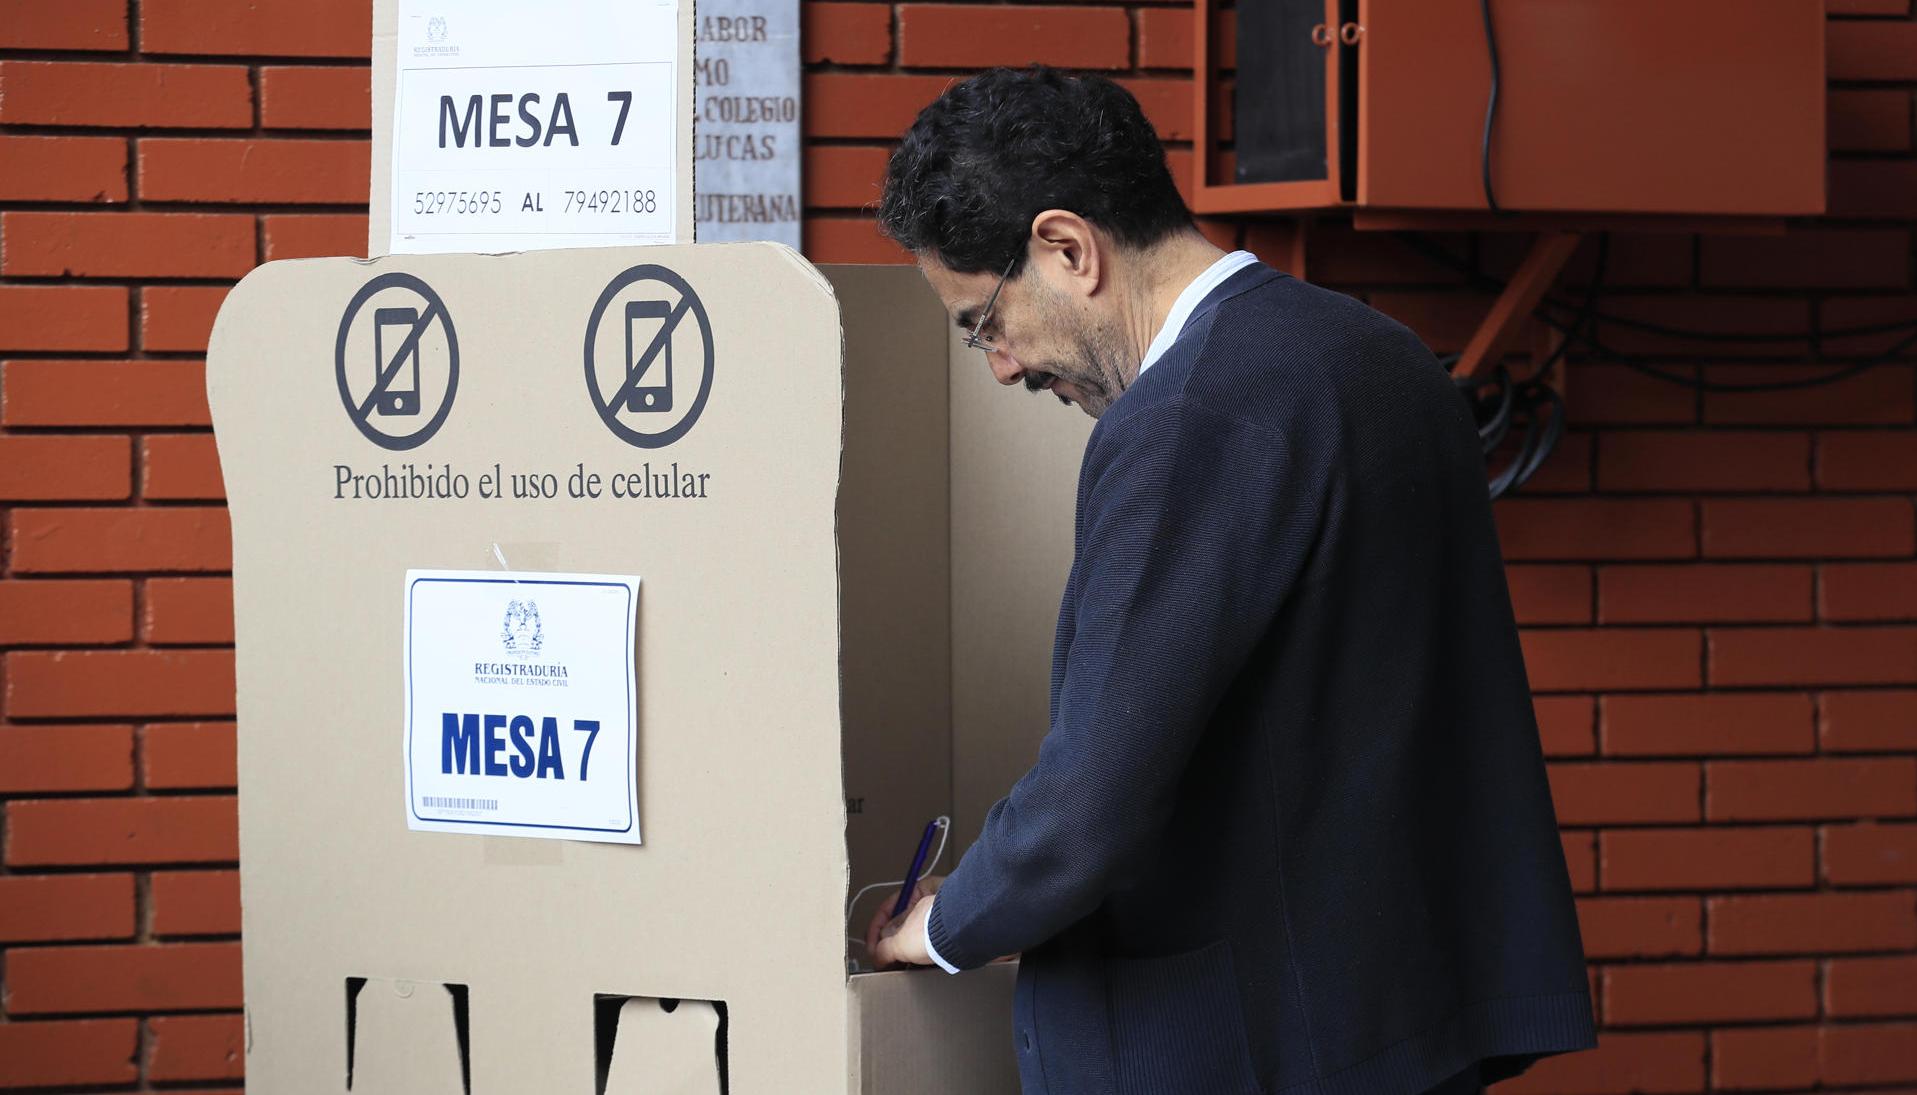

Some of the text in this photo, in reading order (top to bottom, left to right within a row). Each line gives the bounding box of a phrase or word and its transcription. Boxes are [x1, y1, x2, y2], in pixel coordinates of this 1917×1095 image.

[696, 16, 767, 42] ABOR
[438, 90, 633, 149] MESA 7
[705, 96, 796, 124] COLEGIO
[414, 189, 657, 215] 52975695 AL 79492188
[333, 462, 711, 500] Prohibido el uso de celular
[474, 661, 569, 678] REGISTRADURÍA
[474, 676, 508, 685] NACIONAL
[441, 712, 601, 782] MESA 7
